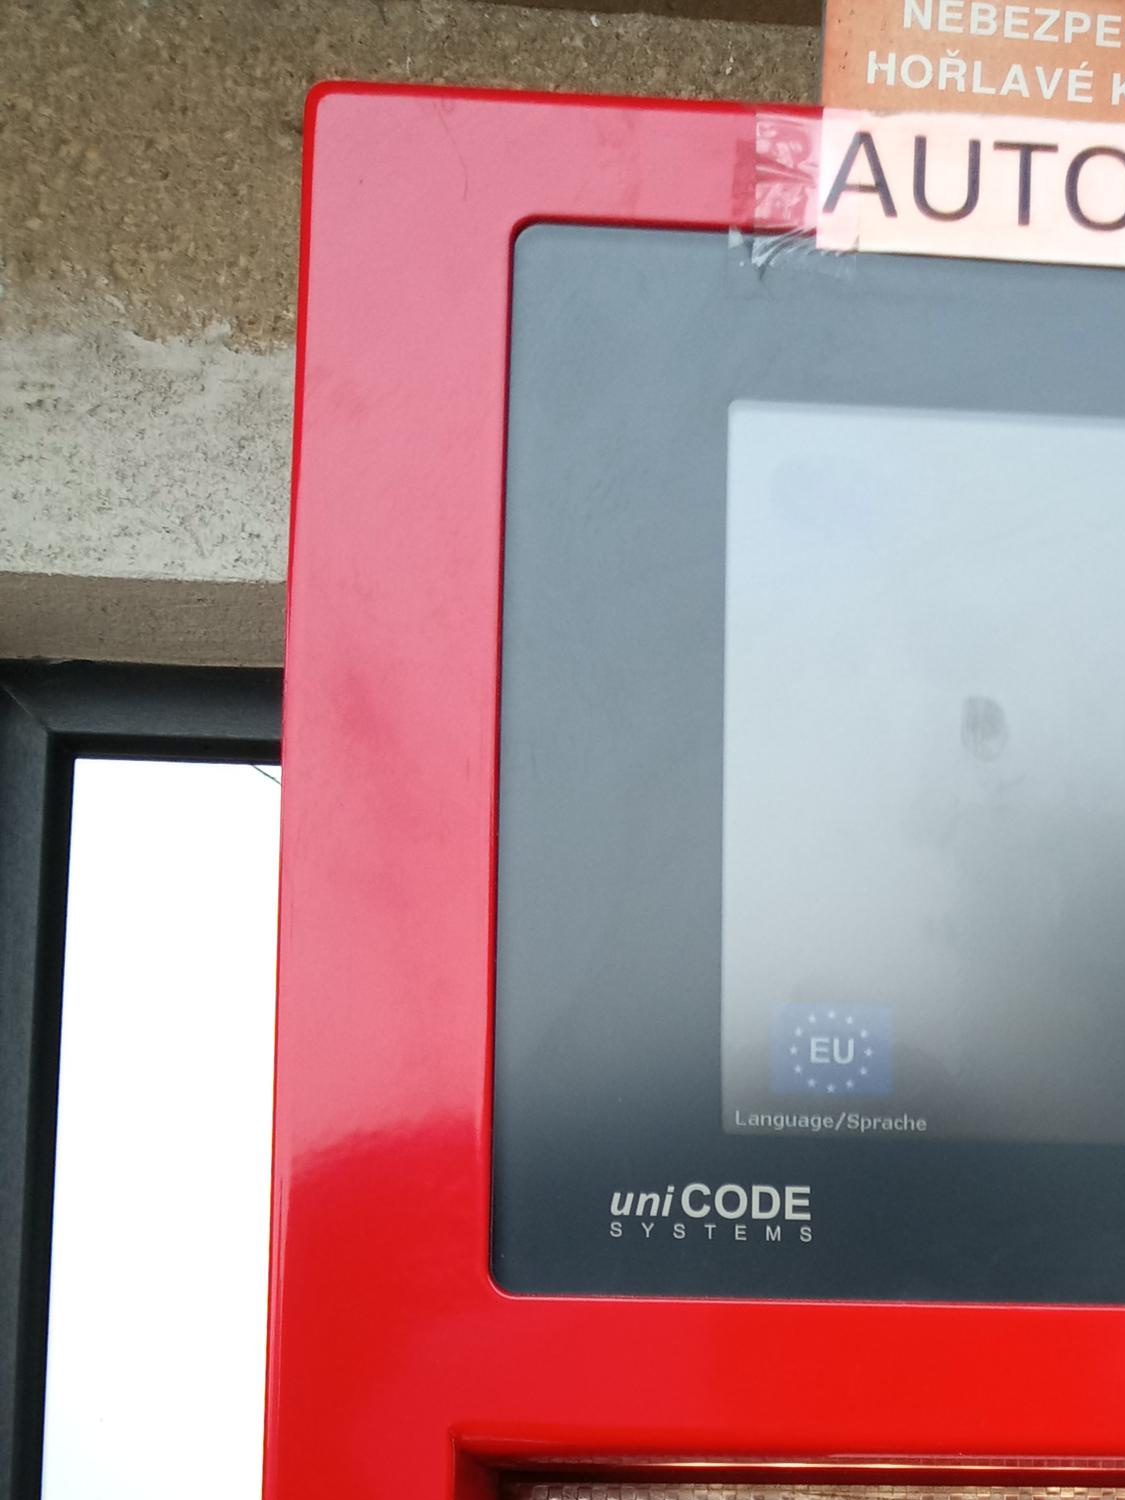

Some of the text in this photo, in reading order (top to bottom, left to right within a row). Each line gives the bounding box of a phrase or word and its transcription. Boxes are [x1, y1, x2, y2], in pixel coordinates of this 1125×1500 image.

[867, 48, 1093, 103] HOŘLAVÉ
[810, 1036, 855, 1064] EU
[735, 1110, 927, 1133] Language/Sprache
[609, 1182, 812, 1221] uniCODE
[609, 1222, 813, 1242] SYSTEMS
